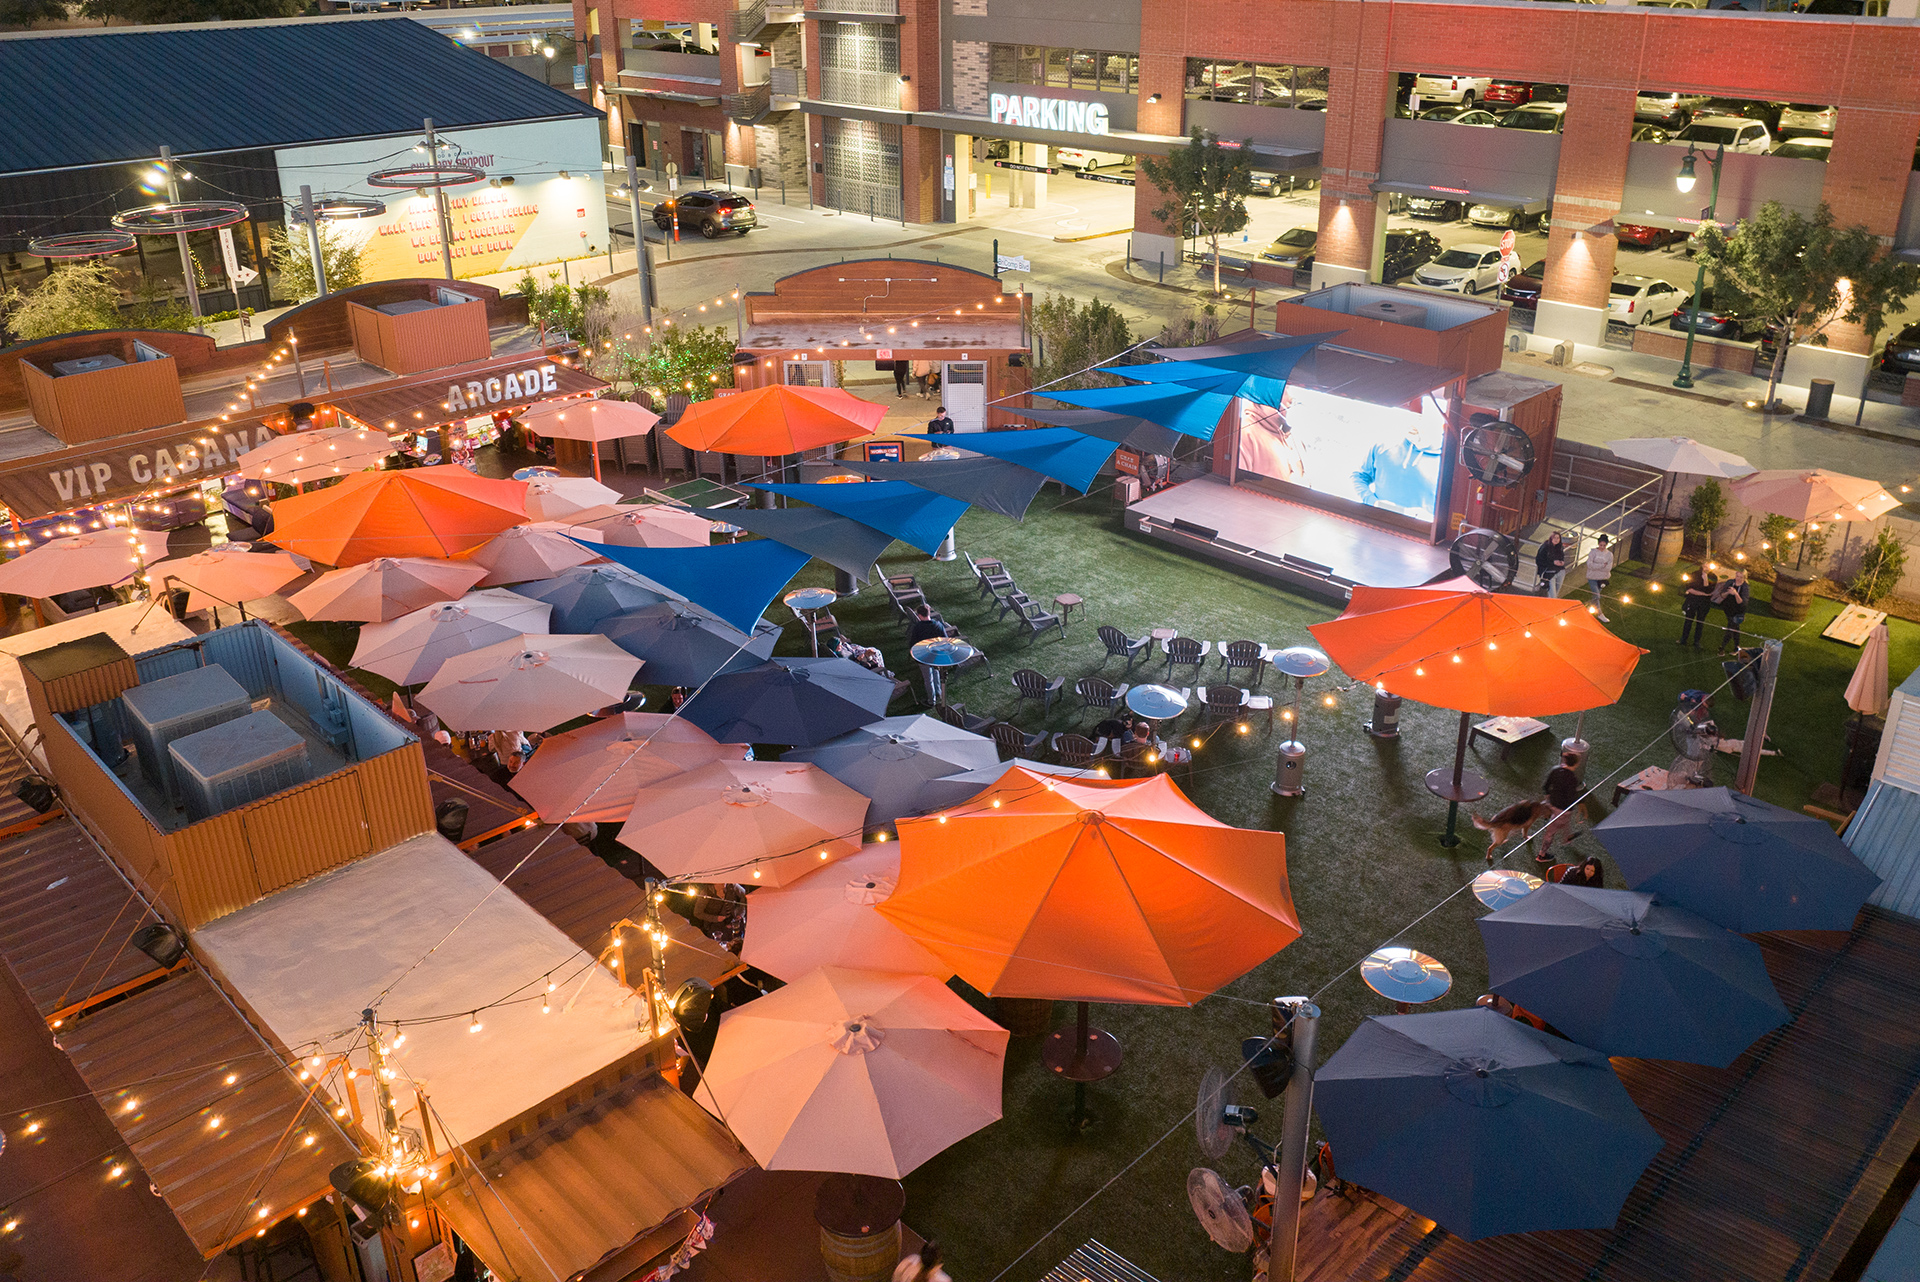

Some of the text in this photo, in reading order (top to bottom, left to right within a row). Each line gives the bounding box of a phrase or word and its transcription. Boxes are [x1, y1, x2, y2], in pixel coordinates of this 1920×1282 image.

[990, 92, 1109, 135] PARKING
[503, 203, 539, 219] FEELING
[411, 234, 426, 248] WE
[469, 222, 516, 240] TOGETHER
[1500, 238, 1514, 250] STOP
[450, 245, 467, 259] LET
[471, 243, 484, 256] ME
[487, 238, 513, 253] DOWN
[448, 364, 558, 413] ARCADE
[49, 426, 273, 501] VIP CABANA
